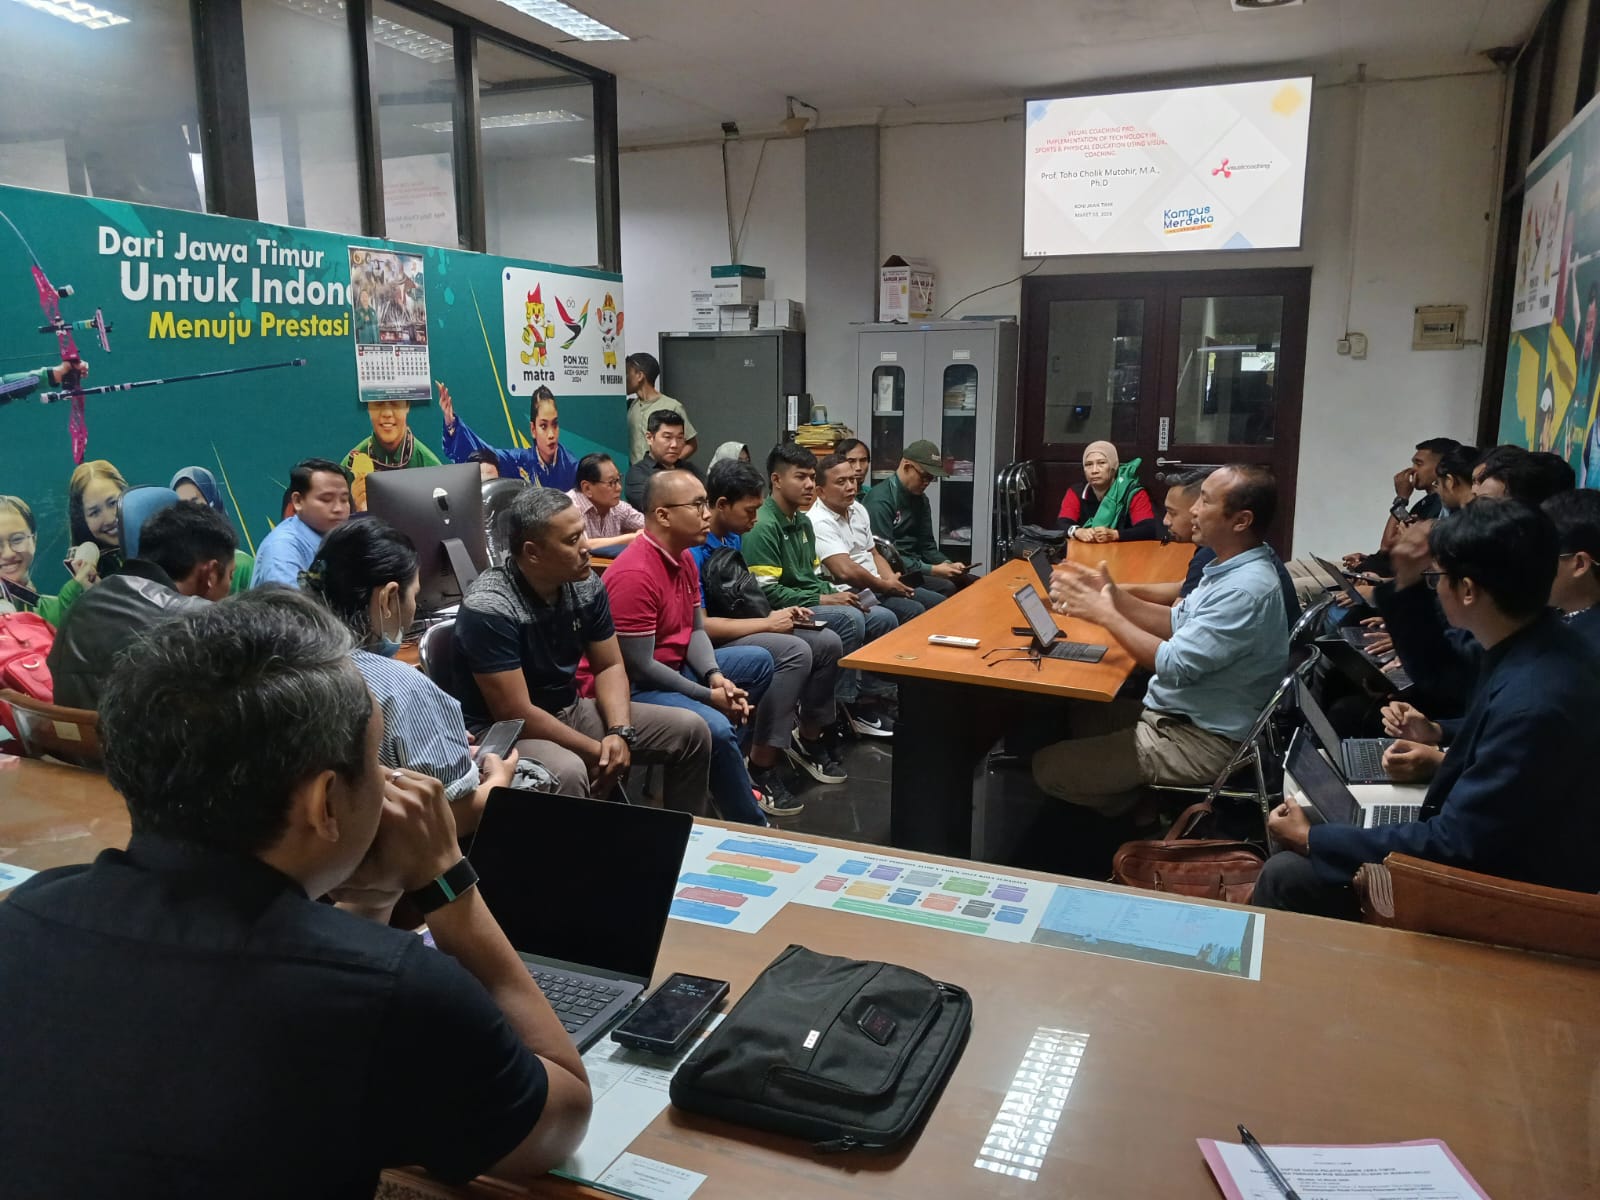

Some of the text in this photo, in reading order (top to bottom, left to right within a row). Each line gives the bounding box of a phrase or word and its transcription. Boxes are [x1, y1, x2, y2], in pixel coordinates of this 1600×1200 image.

[1089, 126, 1120, 135] COACHING
[1046, 136, 1098, 145] IMPLEMENTATION
[1109, 132, 1148, 141] TECHNOLOGY
[1064, 144, 1090, 152] PHYSICAL
[1091, 142, 1125, 150] EDUCATION
[1127, 140, 1146, 148] USING
[1079, 168, 1103, 178] Cholik
[1104, 167, 1138, 177] Mutohir,
[1163, 205, 1211, 219] Kampus
[1163, 215, 1214, 229] Merdeka
[98, 225, 325, 268] Dari Jawa Timur
[120, 260, 240, 303] Untuk
[148, 311, 349, 345] Menuju Prestasi
[563, 355, 588, 365] PON XXI
[523, 368, 555, 381] matra
